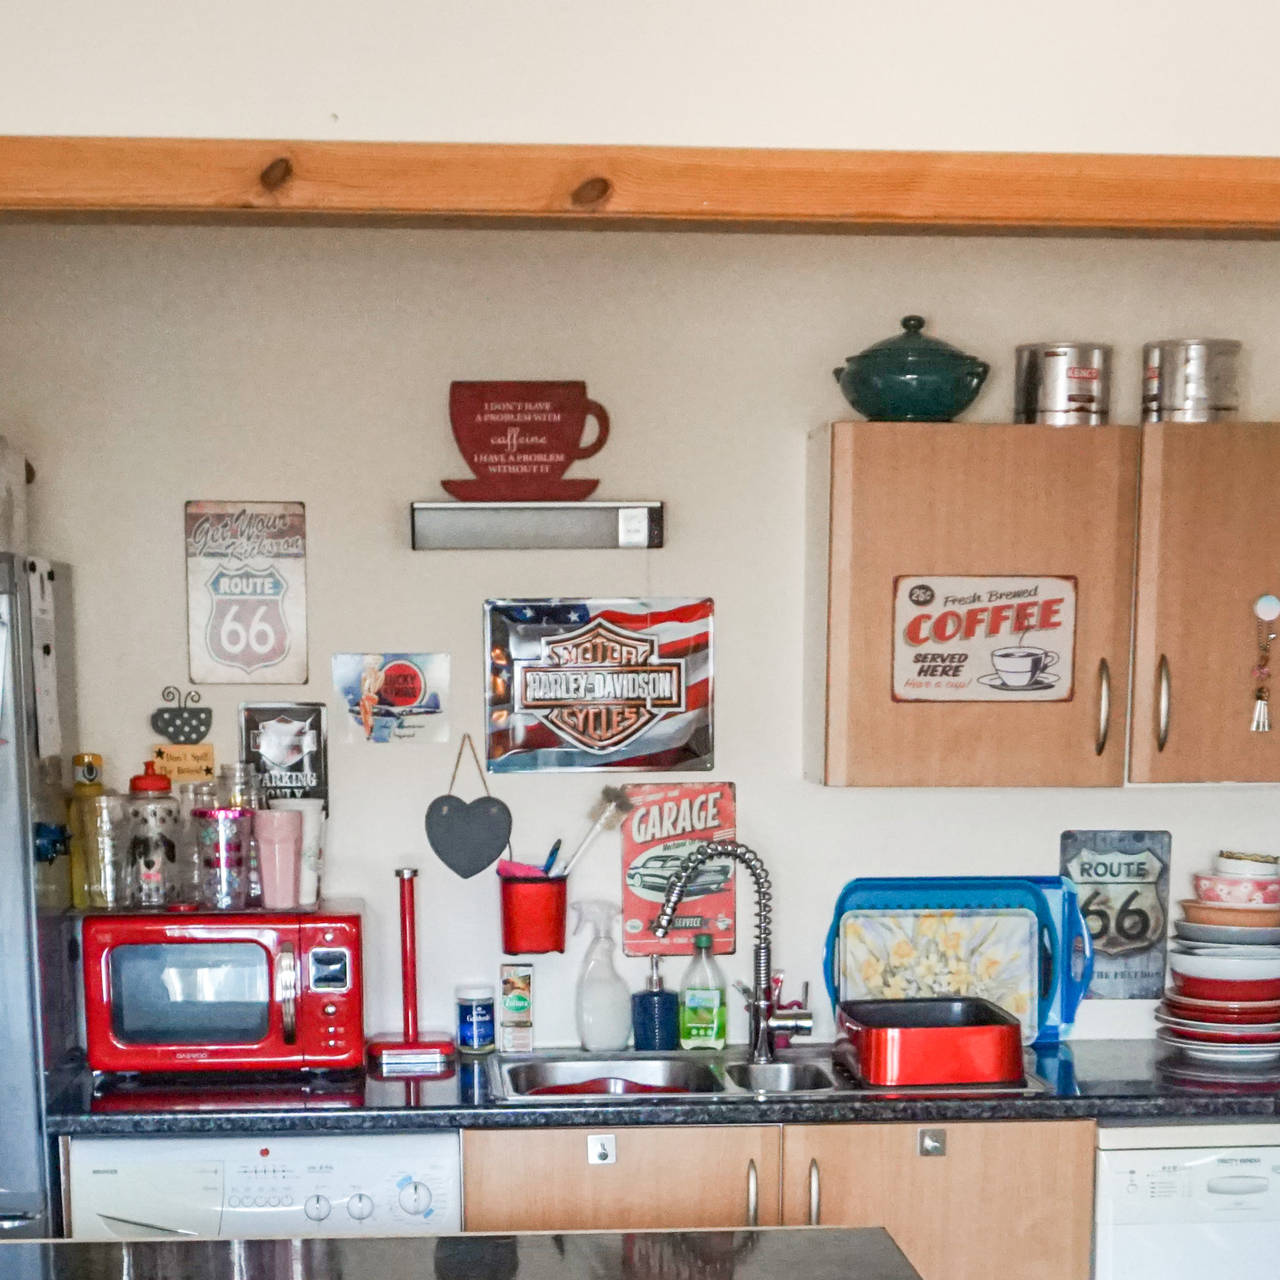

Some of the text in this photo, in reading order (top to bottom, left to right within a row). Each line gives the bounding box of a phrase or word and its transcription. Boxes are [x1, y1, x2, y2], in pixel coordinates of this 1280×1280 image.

[475, 413, 561, 422] A PROBLEM WITH
[524, 401, 551, 411] HAVE
[490, 426, 547, 452] caffeine
[479, 453, 508, 463] HAVE
[518, 453, 565, 463] PROBLEM
[488, 464, 537, 474] WITHOUT
[192, 507, 290, 556] Get Your
[218, 576, 275, 595] ROUTE
[943, 585, 1040, 608] Fresh Brewed
[219, 604, 276, 655] 66
[905, 597, 1065, 647] COFFEE
[562, 635, 642, 665] MOTOR
[912, 652, 969, 665] SERVED
[917, 664, 965, 678] HERE
[527, 671, 671, 700] HARLEY-DAVIDSON
[562, 706, 639, 742] CYCLES
[631, 790, 722, 845] GARAGE
[1079, 861, 1149, 878] ROUTE
[1080, 889, 1150, 940] 66
